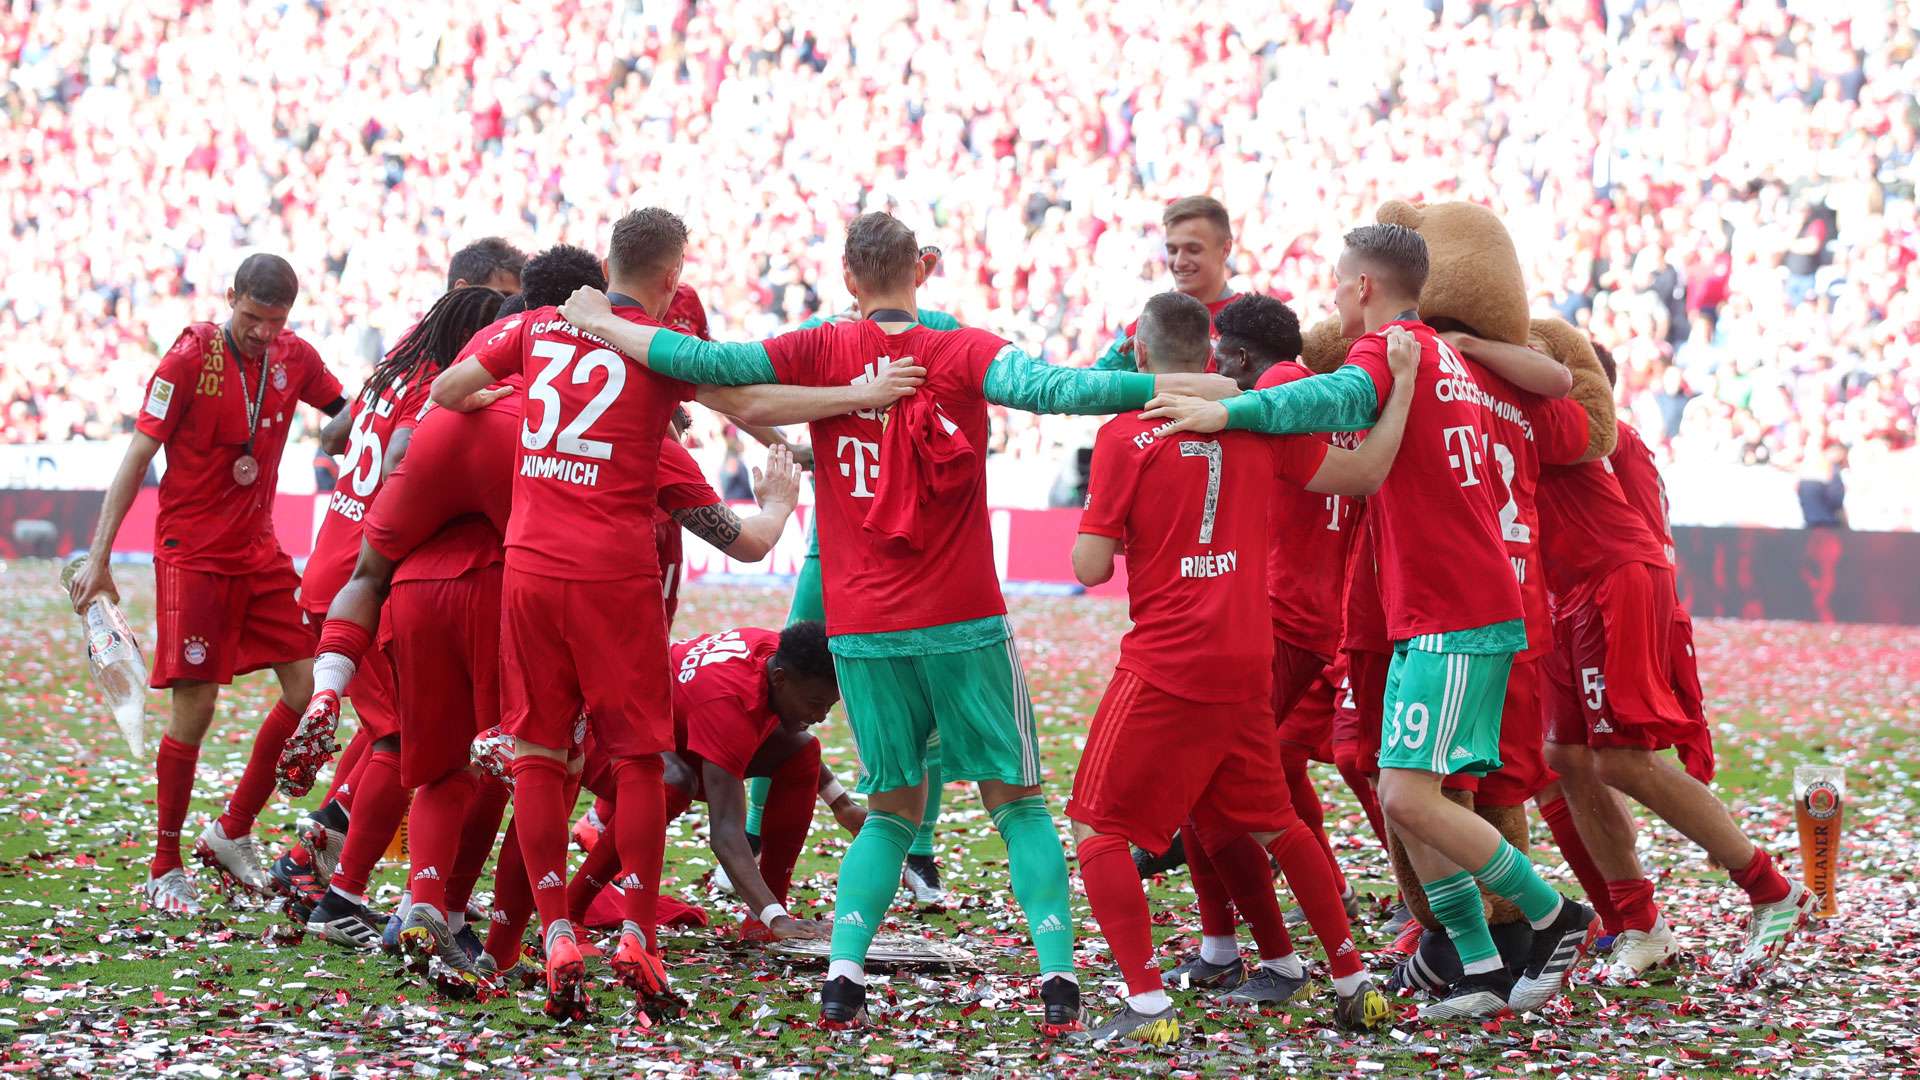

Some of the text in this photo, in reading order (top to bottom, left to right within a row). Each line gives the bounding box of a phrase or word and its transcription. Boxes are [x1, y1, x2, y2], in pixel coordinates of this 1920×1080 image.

[521, 340, 627, 461] 32
[1133, 431, 1154, 450] FC
[520, 455, 599, 486] KIMMICH
[1179, 440, 1223, 544] 7
[1180, 550, 1238, 579] RIBÉRY
[1387, 701, 1430, 750] 39
